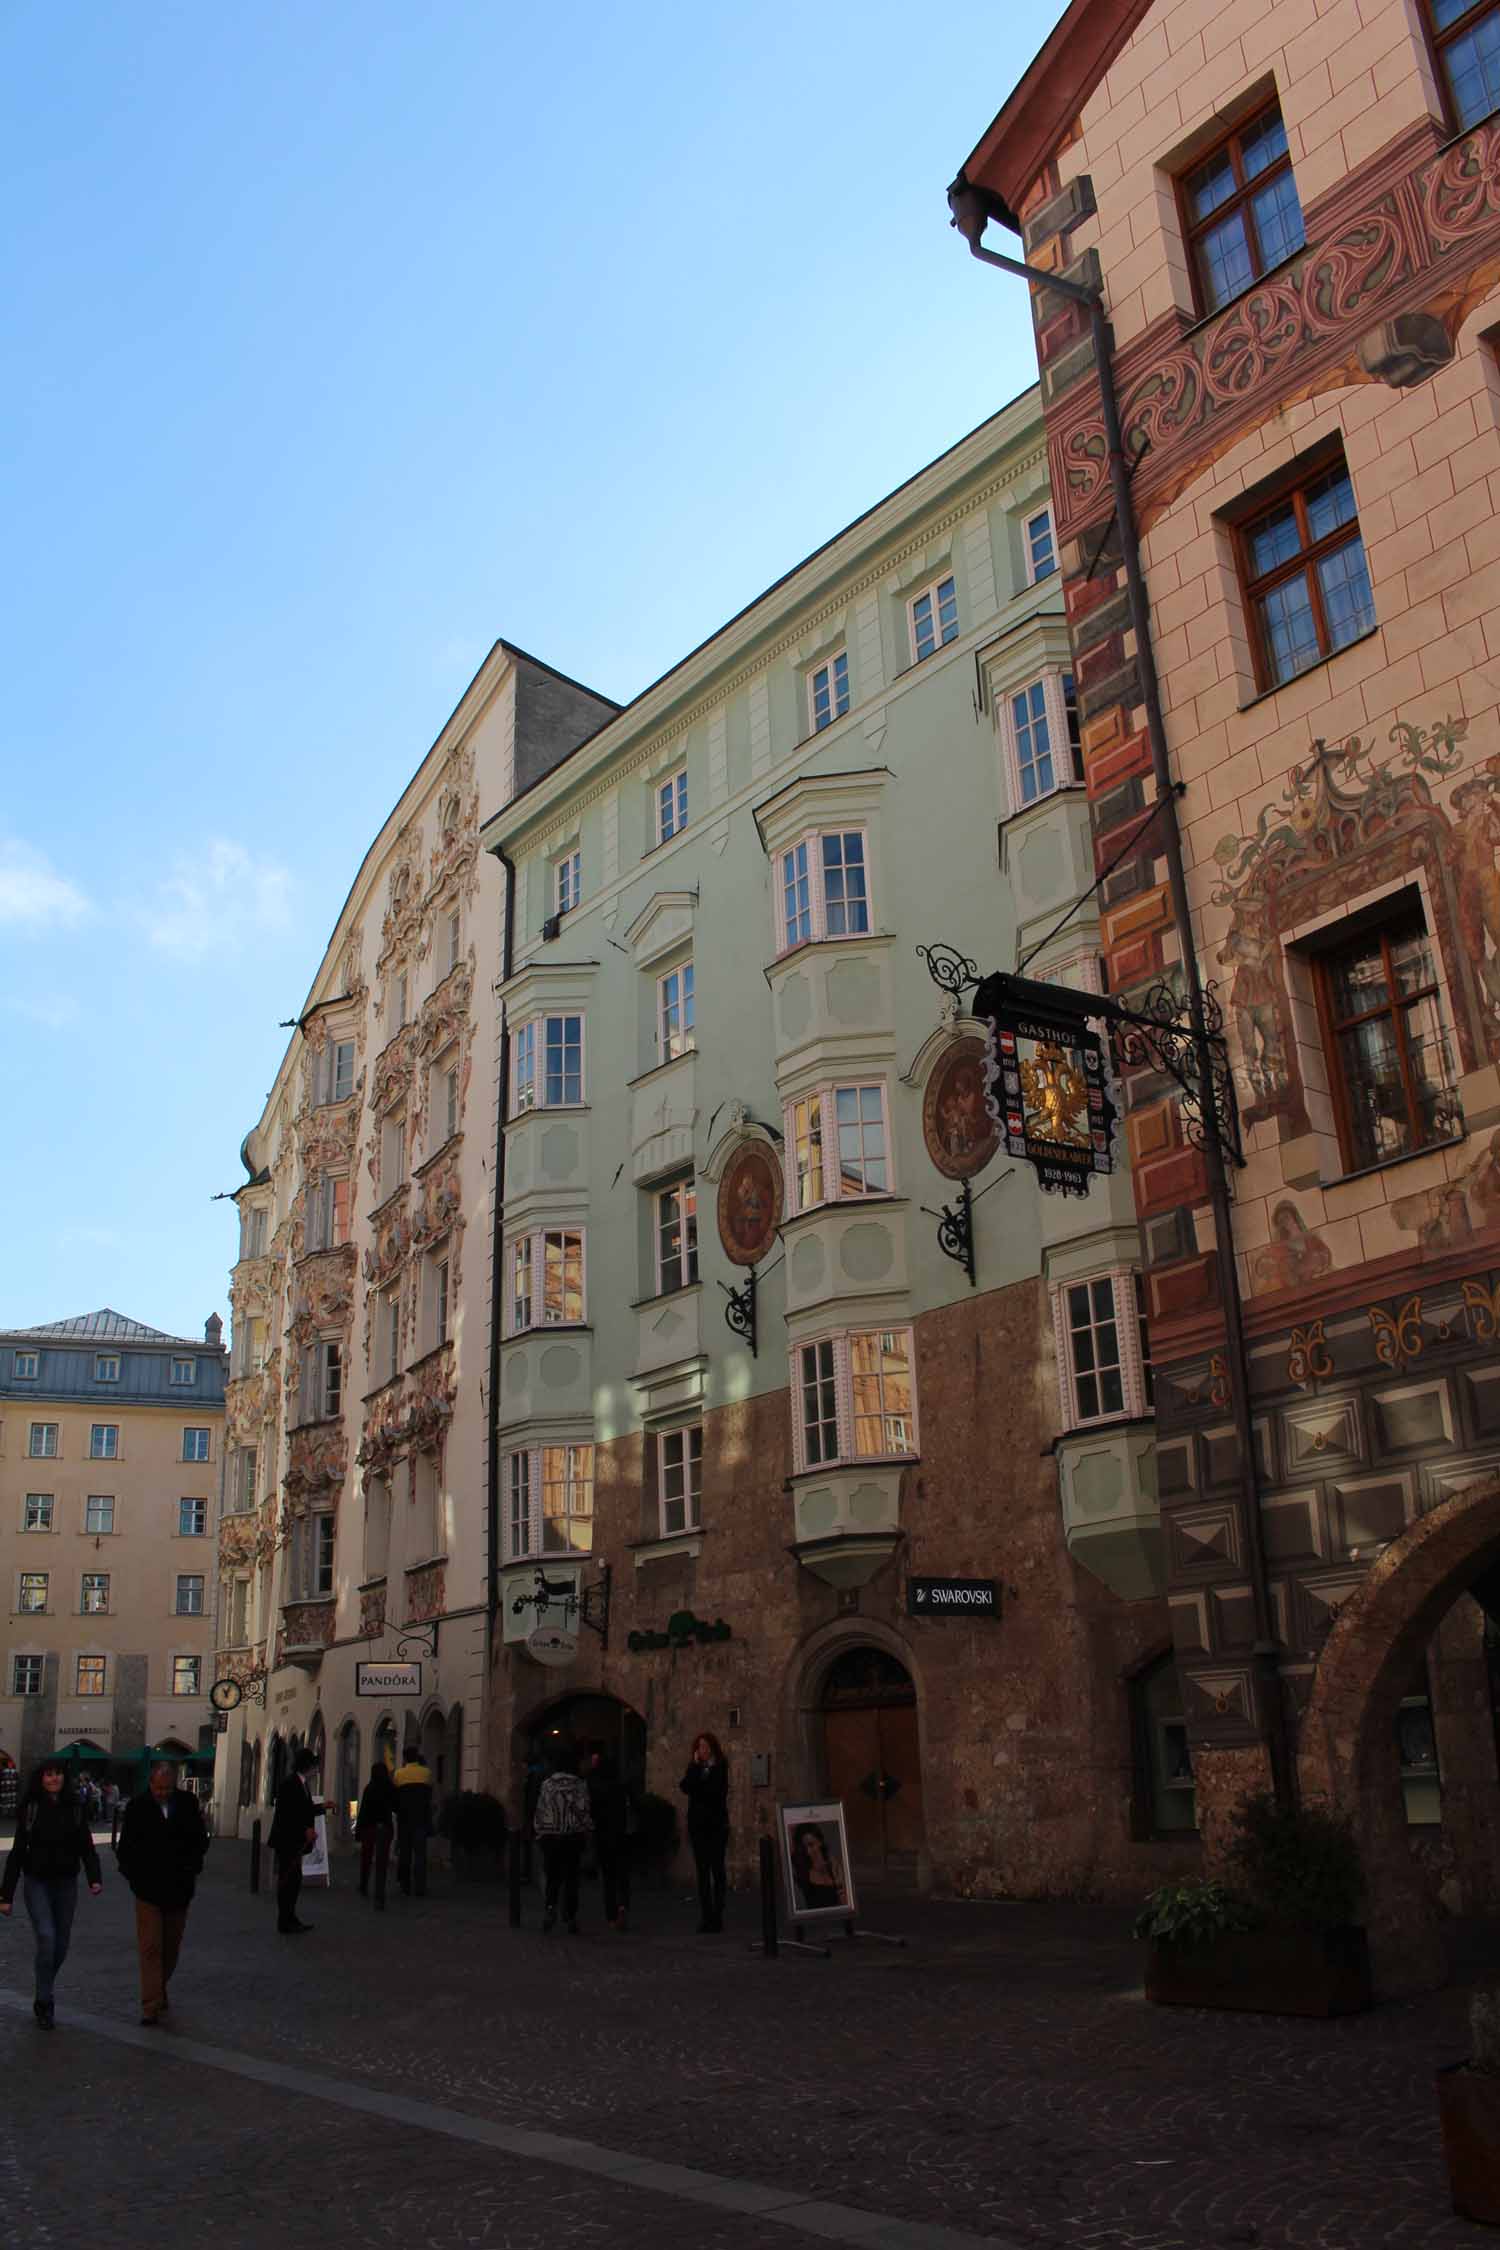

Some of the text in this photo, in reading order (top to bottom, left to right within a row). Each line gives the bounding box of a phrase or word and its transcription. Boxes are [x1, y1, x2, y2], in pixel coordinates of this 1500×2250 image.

[1018, 1022, 1079, 1047] GASTHOF
[931, 1588, 993, 1604] SWAROVSKI
[361, 1675, 418, 1687] PANDORA
